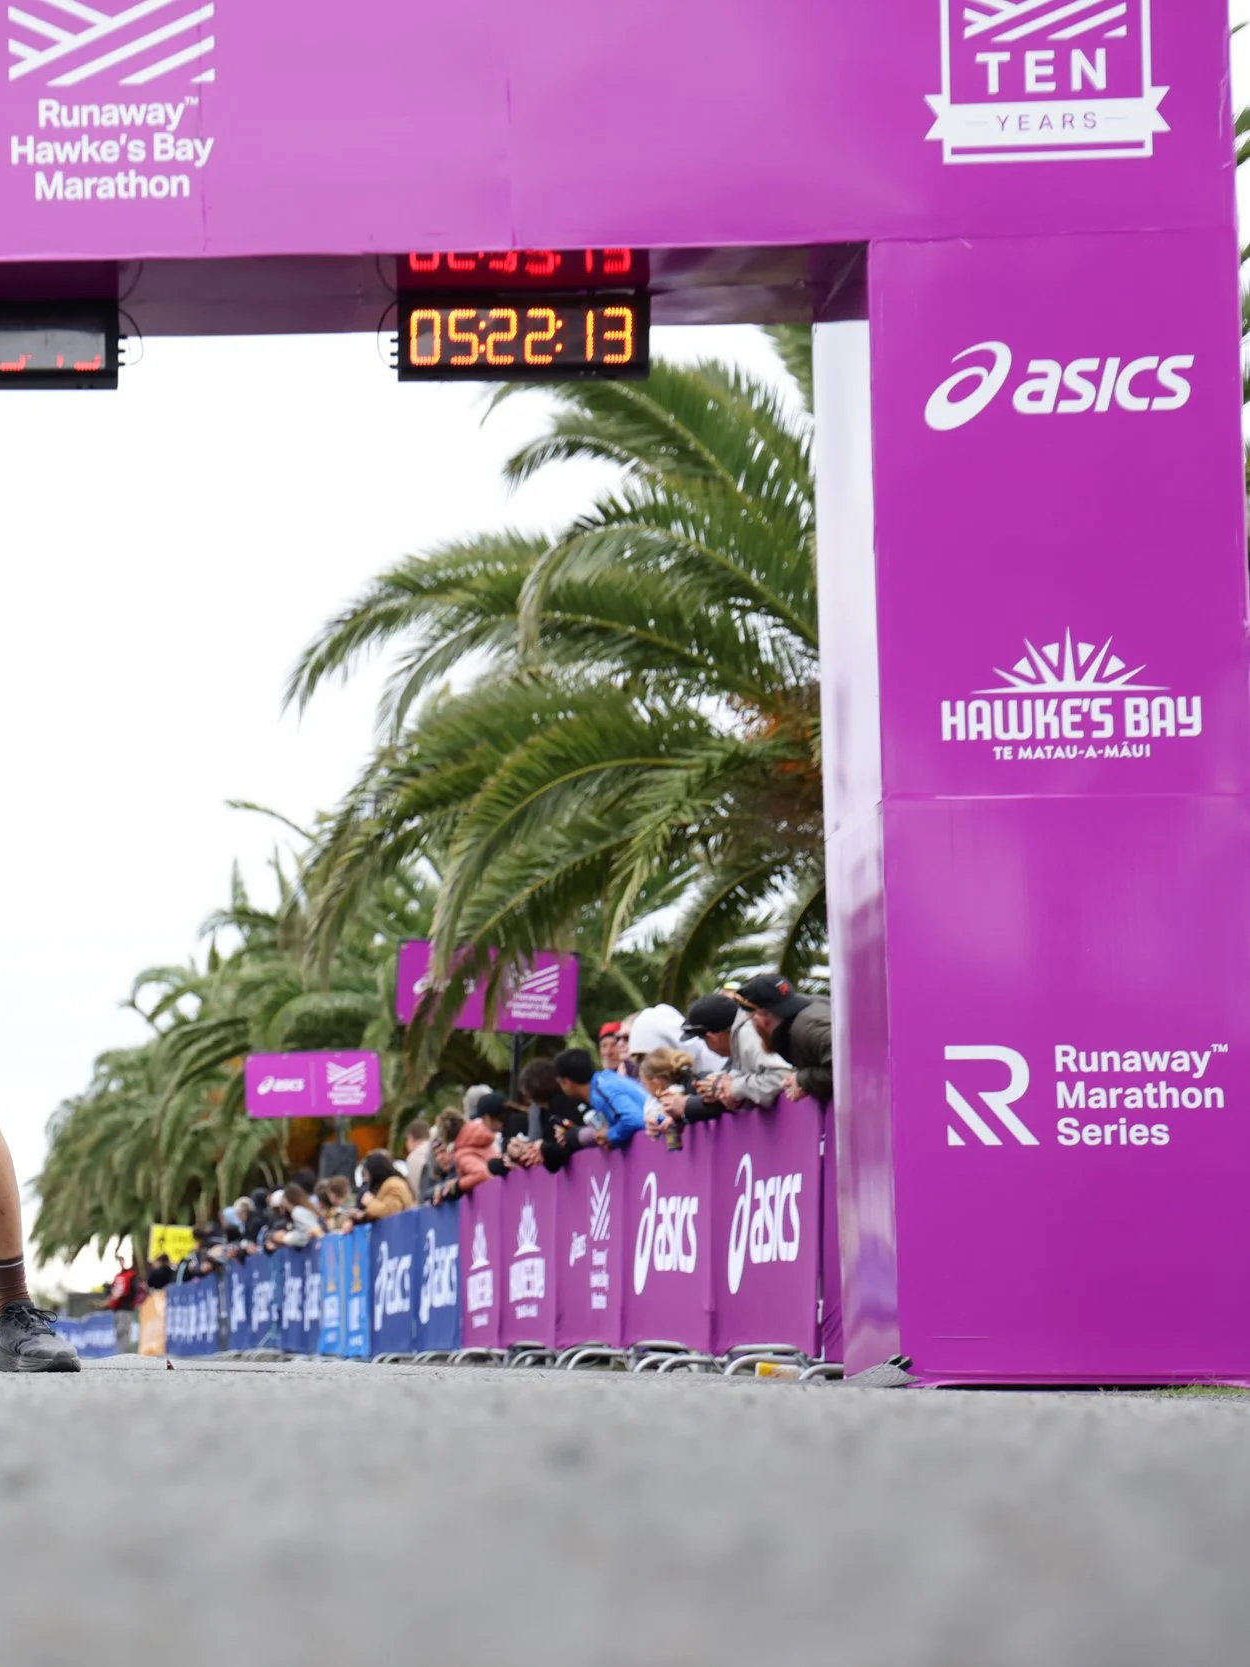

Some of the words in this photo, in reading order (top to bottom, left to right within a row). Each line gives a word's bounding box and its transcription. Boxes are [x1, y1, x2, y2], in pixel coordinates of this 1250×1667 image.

[975, 47, 1107, 94] TEN
[993, 110, 1102, 132] YEARS
[10, 133, 146, 165] Hawke's
[153, 129, 214, 168] Bay
[35, 169, 190, 200] Marathon
[410, 307, 633, 366] 05:22:13
[941, 697, 1114, 741] HAWKE'S
[1124, 696, 1202, 738] BAY
[993, 746, 1013, 761] TE
[1056, 1080, 1225, 1109] Marathon
[1057, 1117, 1170, 1146] Series
